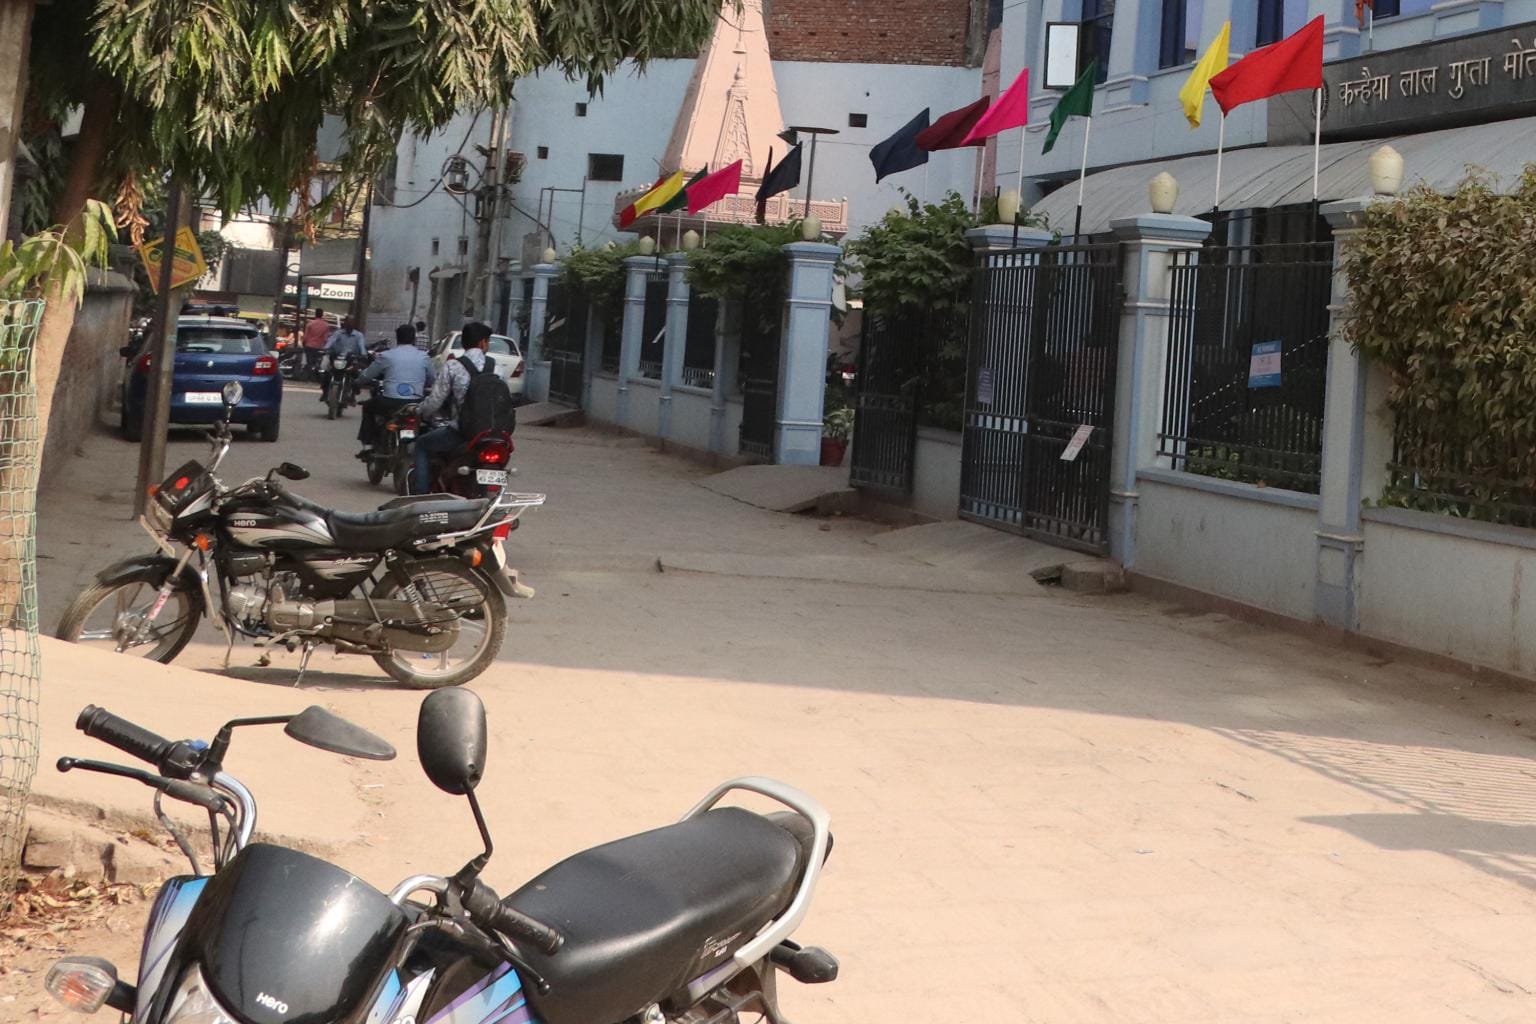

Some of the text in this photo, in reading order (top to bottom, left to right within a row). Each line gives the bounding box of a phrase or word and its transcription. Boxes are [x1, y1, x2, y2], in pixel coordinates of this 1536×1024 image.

[1339, 66, 1390, 107] कन्हैया
[1400, 65, 1439, 97] लाल
[1449, 56, 1492, 99] गुप्ता
[322, 287, 354, 298] Zoom
